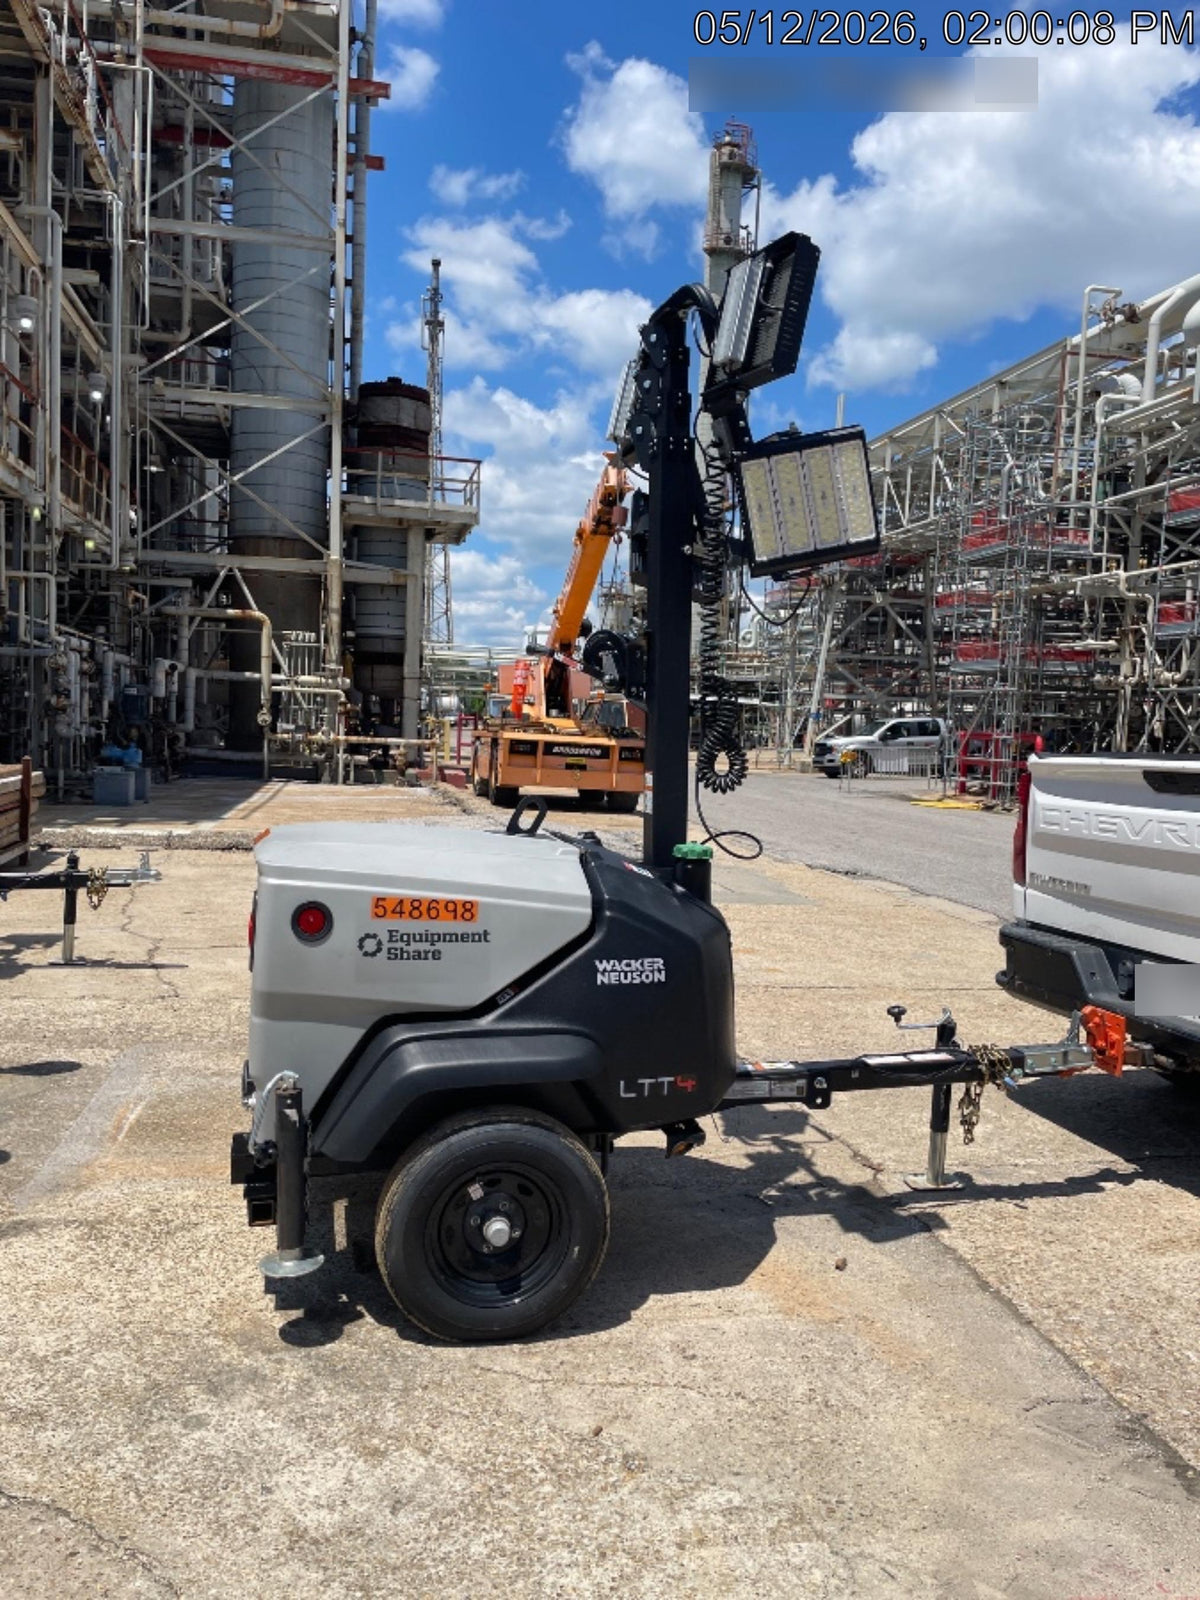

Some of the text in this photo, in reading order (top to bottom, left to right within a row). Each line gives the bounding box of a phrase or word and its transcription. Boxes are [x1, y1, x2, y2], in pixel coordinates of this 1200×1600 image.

[374, 897, 476, 922] 548698
[387, 929, 491, 947] Equipment
[387, 947, 442, 961] Share
[594, 957, 666, 972] WACKER
[596, 970, 666, 986] NEUSON
[619, 1075, 696, 1098] LTT4
